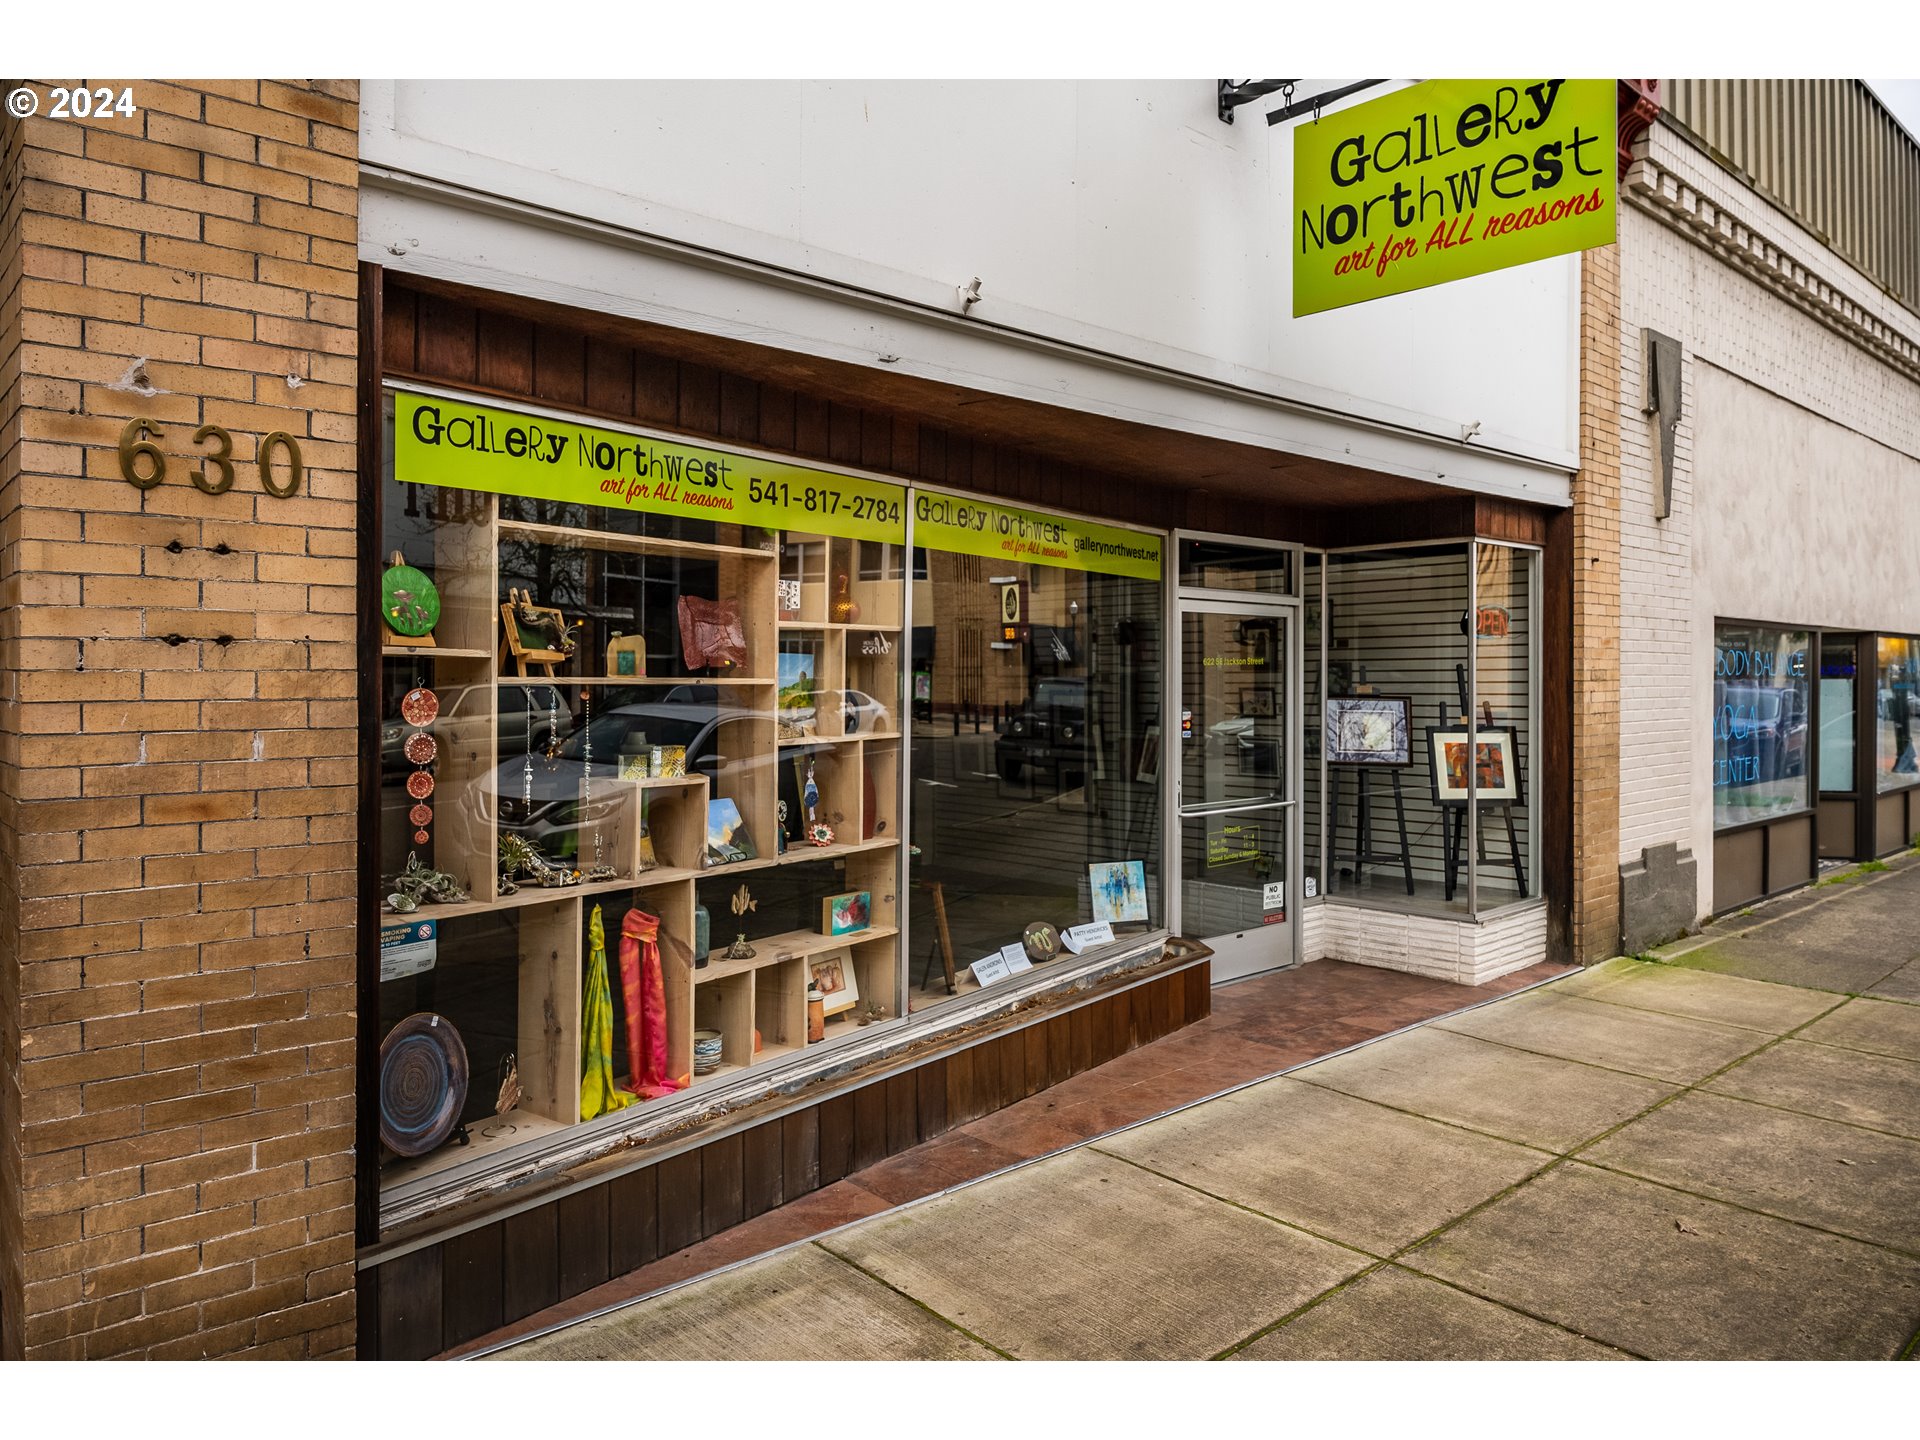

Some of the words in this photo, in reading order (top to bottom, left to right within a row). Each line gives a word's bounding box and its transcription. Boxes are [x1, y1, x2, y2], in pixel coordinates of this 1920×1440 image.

[1302, 126, 1603, 254] Northwest
[1334, 241, 1375, 276] art
[1376, 234, 1418, 277] for
[1425, 213, 1473, 253] ALL
[1482, 188, 1604, 241] reasons
[119, 417, 303, 499] 630
[578, 432, 734, 491] Northwest
[748, 477, 900, 525] 541-817-2784
[600, 477, 625, 495] art
[625, 477, 650, 504] for
[653, 481, 679, 502] ALL
[682, 490, 734, 511] reasons
[991, 508, 1068, 545] Northwest
[1073, 536, 1159, 562] gallerynorthwest.net
[1001, 538, 1014, 550] art
[1014, 539, 1026, 557] for
[1027, 541, 1040, 555] ALL
[1041, 546, 1068, 559] reasons
[1247, 657, 1264, 666] Street
[1716, 649, 1753, 676] BODY
[1712, 704, 1758, 740] YOGA
[1713, 755, 1760, 786] CENTER
[1269, 885, 1278, 893] NO
